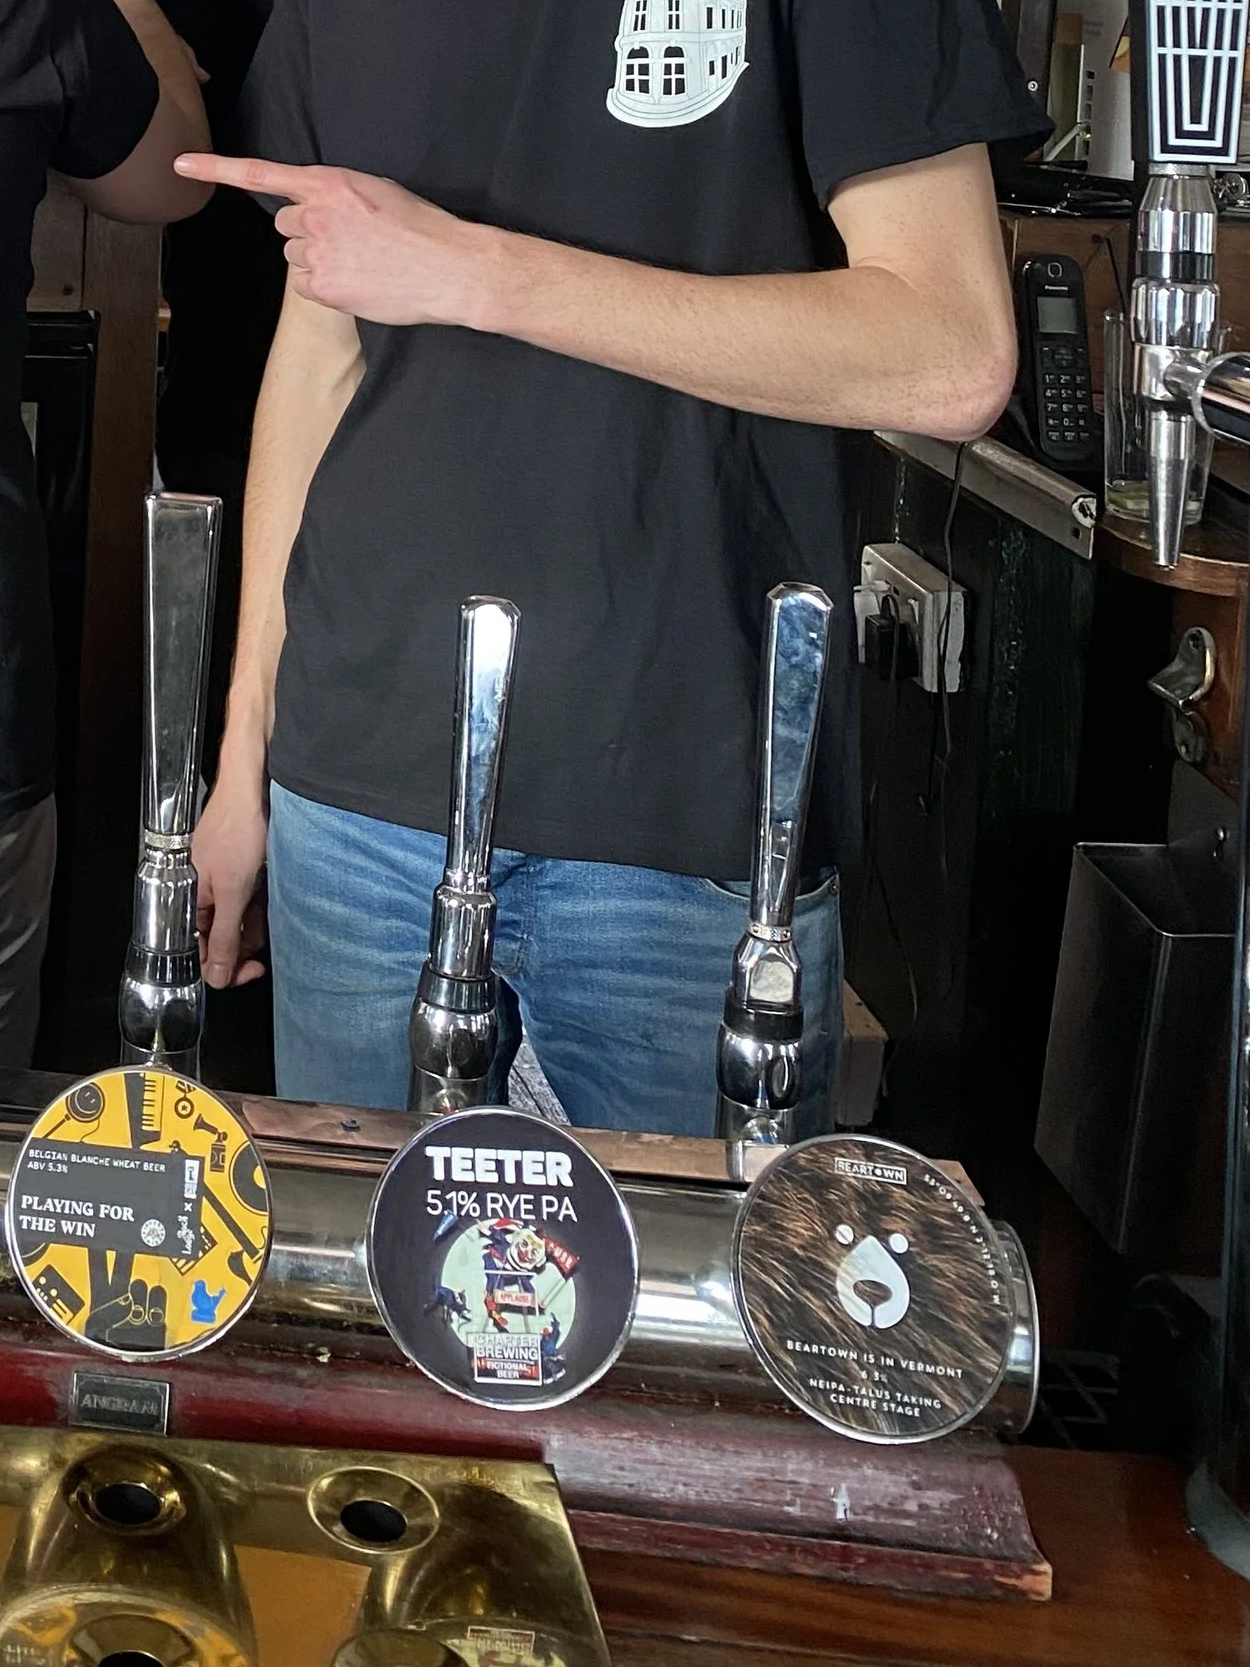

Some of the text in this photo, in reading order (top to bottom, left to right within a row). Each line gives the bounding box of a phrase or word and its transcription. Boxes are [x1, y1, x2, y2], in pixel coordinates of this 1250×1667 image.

[27, 1160, 46, 1171] ABV
[28, 1148, 166, 1174] BELGIAN BLANCHE WHEAT BEER
[424, 1145, 574, 1188] TEETER
[20, 1194, 135, 1223] PLAYING FOR
[426, 1189, 578, 1223] 5.1% RYE PA
[18, 1214, 95, 1238] THE WIN
[475, 1346, 539, 1360] BREWING
[786, 1339, 964, 1380] BEARTOWN IS IN VERMONT
[829, 1393, 921, 1418] CENTRE STAGE
[895, 1391, 943, 1410] TAKING
